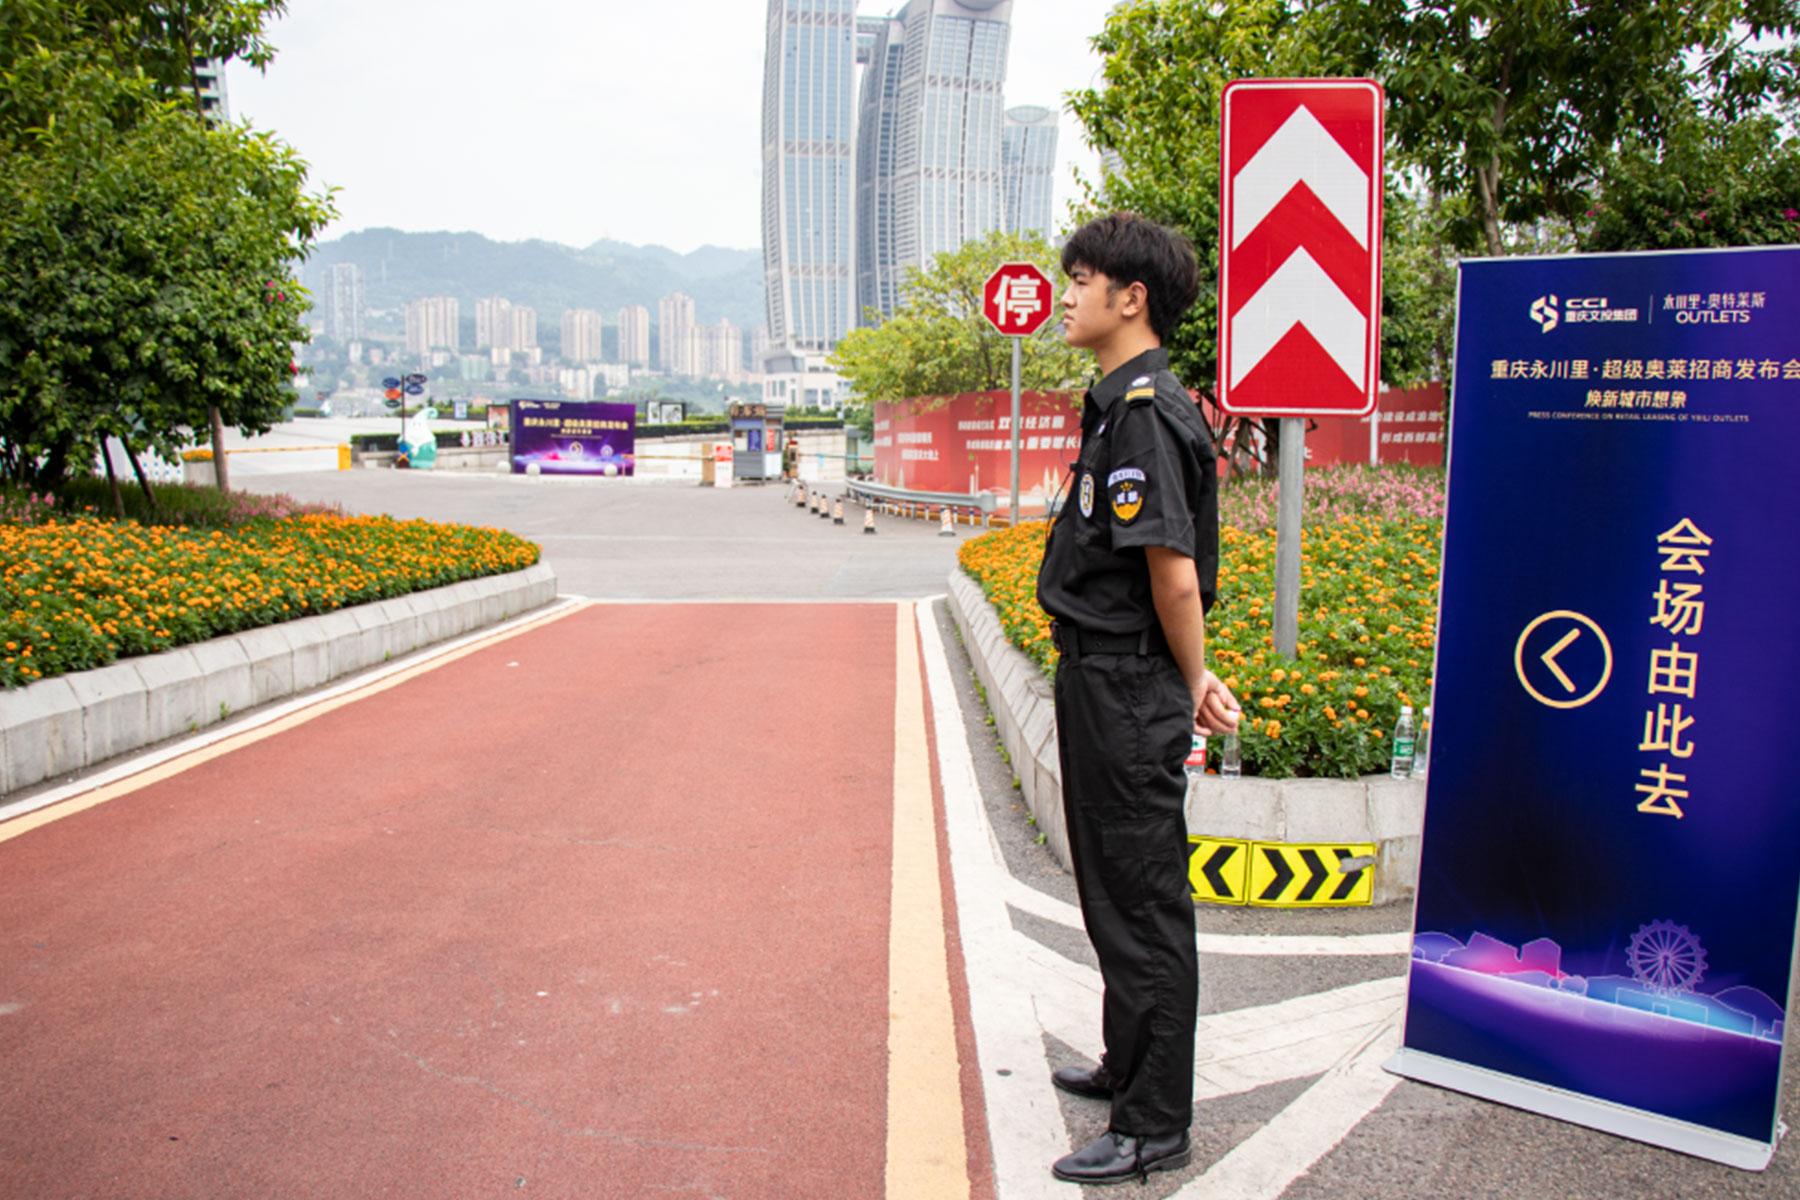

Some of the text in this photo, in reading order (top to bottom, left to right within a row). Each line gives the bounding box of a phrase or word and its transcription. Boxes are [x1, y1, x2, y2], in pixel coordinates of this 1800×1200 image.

[992, 274, 1041, 326] 停
[1566, 297, 1608, 309] CCI
[1564, 308, 1638, 323] 重庆文投集团
[1676, 309, 1751, 324] OUTLETS
[1584, 388, 1687, 409] 焕新城市想象
[1528, 411, 1551, 419] PRESS
[1552, 411, 1600, 420] CONFERENCE
[1602, 412, 1614, 420] ON
[1615, 413, 1641, 421] RETAIL
[1642, 413, 1676, 421] LEASING
[1678, 413, 1689, 422] OF
[1713, 414, 1749, 423] OUTLETS
[1635, 517, 1713, 819] 会场由此去
